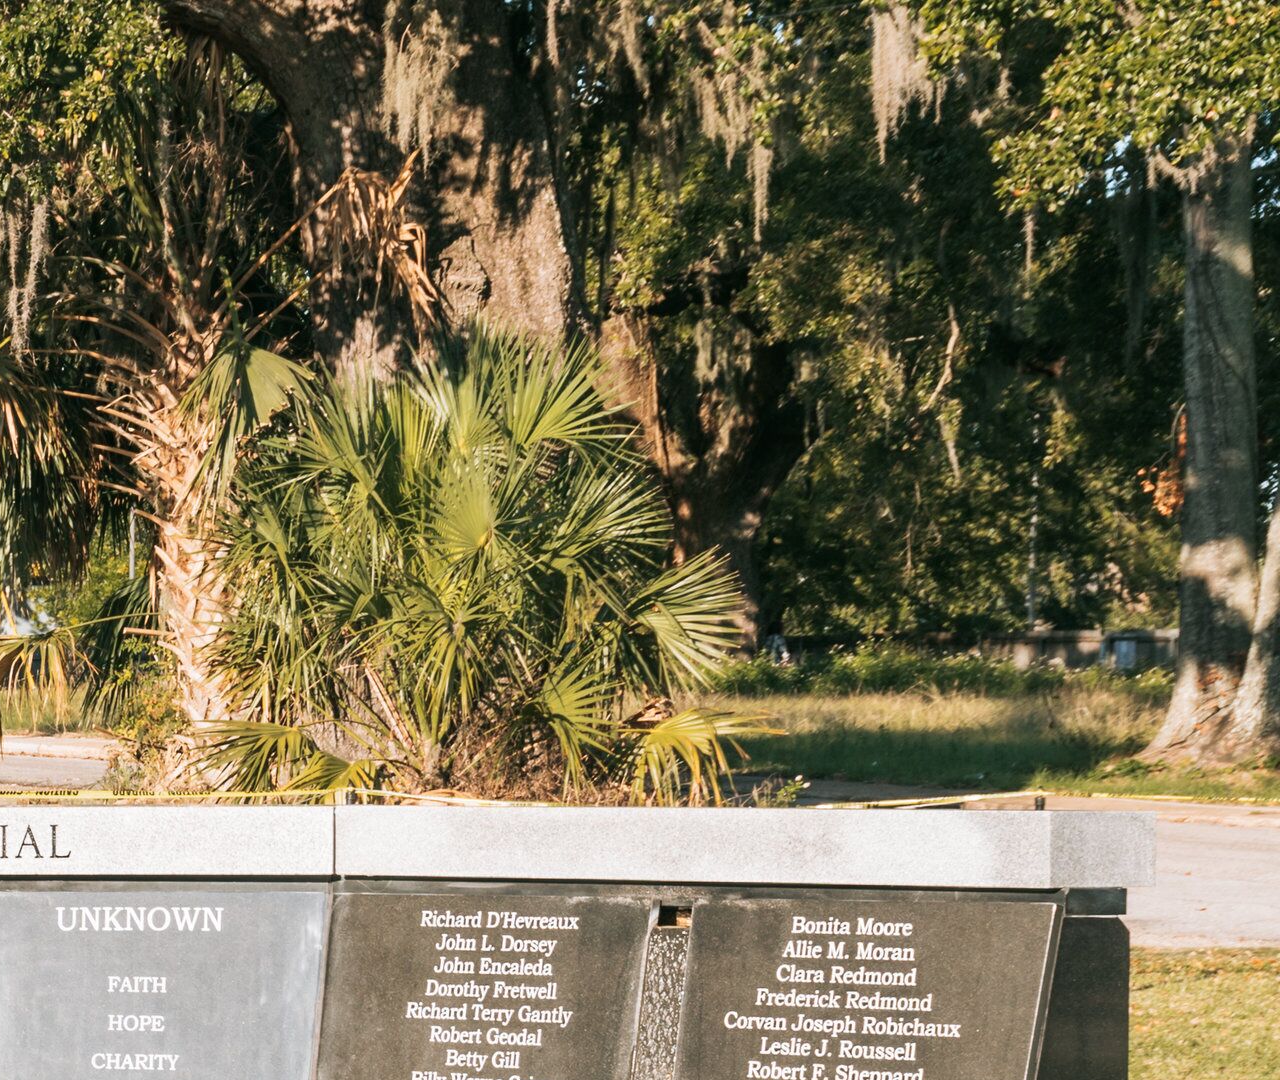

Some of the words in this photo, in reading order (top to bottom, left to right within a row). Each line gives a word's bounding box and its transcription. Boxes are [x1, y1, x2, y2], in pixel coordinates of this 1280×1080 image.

[55, 906, 224, 932] UNKNOWN
[420, 910, 482, 928] Richard
[486, 911, 580, 930] D'Hevreaux
[791, 916, 851, 935] Bonita
[855, 917, 913, 936] Moore
[107, 976, 167, 993] FAITH
[425, 979, 490, 1002] Dorothy
[493, 981, 557, 1000] Fretwell
[755, 988, 841, 1008] Frederick
[845, 991, 932, 1011] Redmond
[107, 1014, 165, 1033] HOPE
[405, 1002, 467, 1020] Richard
[471, 1004, 514, 1026] Terry
[518, 1005, 573, 1028] Gantly
[724, 1011, 787, 1030] Corvan
[791, 1014, 856, 1037] Joseph
[861, 1017, 961, 1038] Robichaux
[91, 1052, 180, 1071] CHARITY
